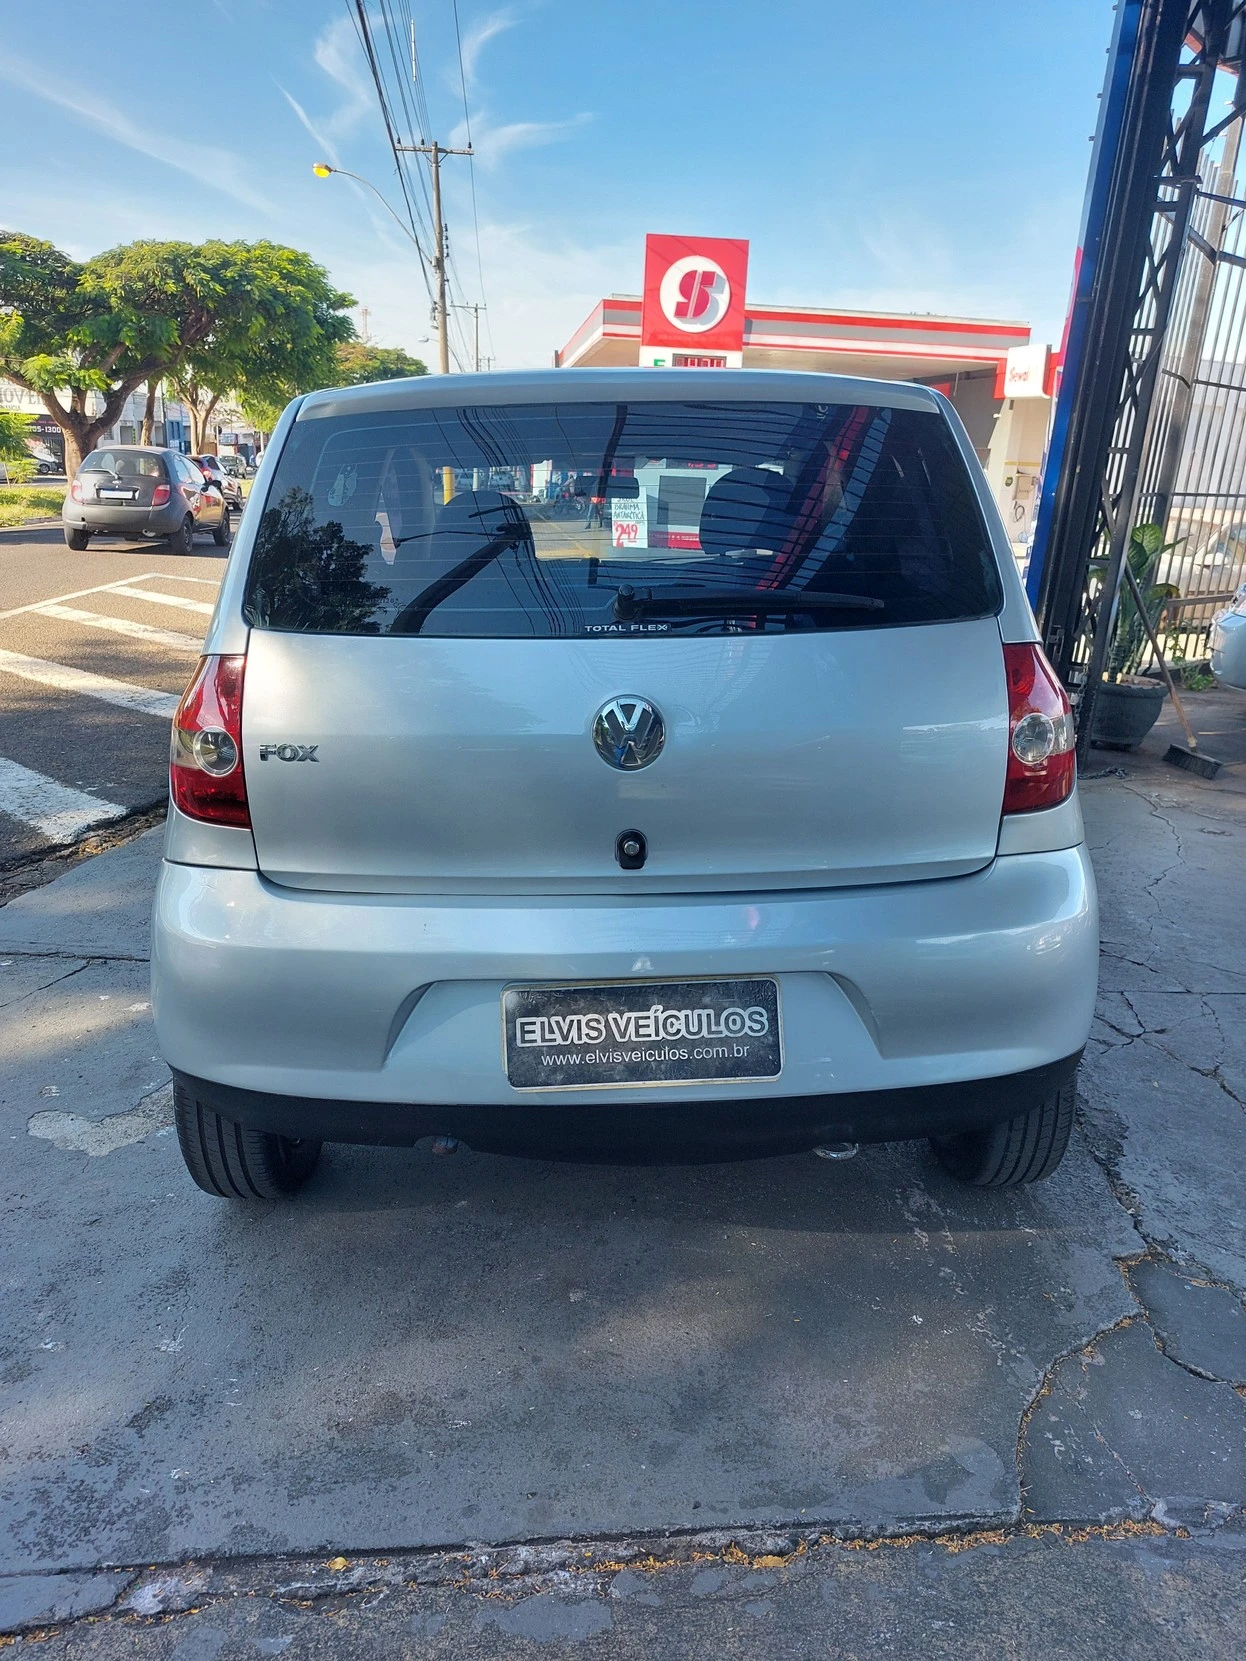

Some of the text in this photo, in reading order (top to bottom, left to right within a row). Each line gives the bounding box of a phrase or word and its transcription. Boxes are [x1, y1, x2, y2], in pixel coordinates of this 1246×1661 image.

[584, 623, 668, 632] TOTAL FLEX
[259, 743, 320, 763] FOX
[515, 1004, 769, 1047] ELVIS VEÍCULOS
[541, 1043, 750, 1066] www.elvisveiculos.com.br
